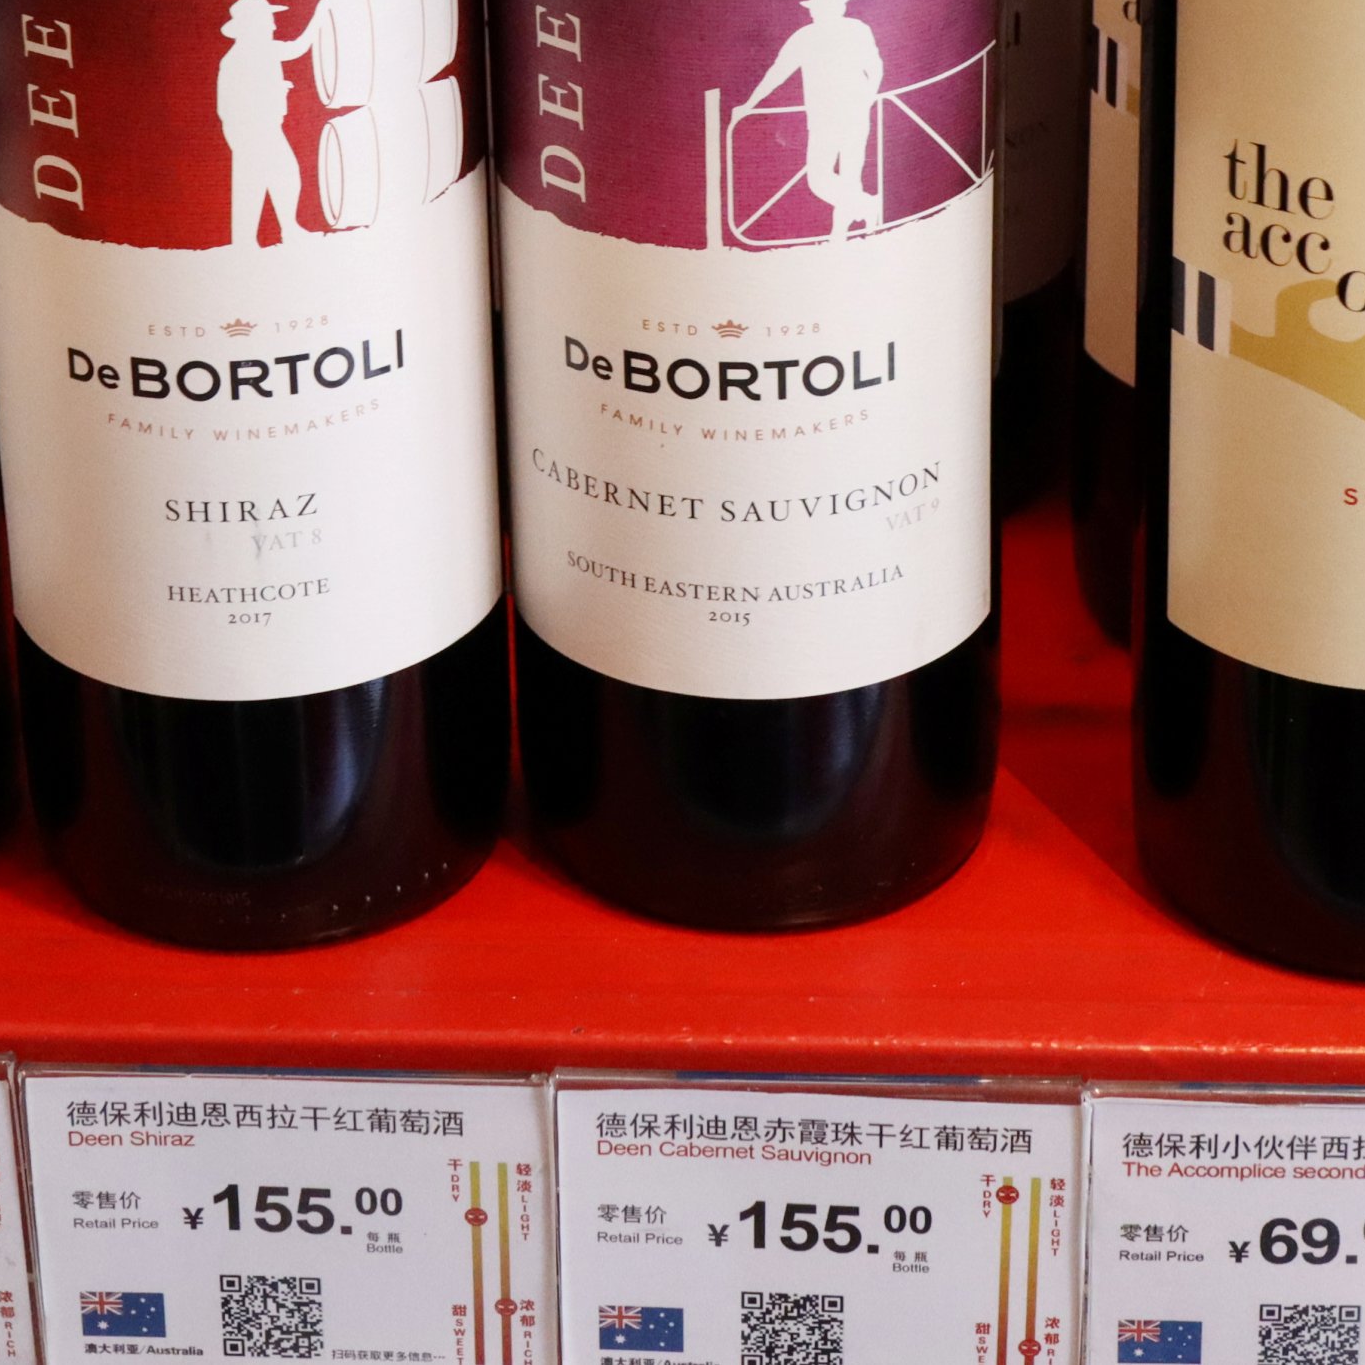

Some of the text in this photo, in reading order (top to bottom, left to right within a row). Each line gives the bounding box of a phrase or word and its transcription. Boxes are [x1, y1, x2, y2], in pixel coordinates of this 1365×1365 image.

[1223, 138, 1335, 220] the
[149, 315, 329, 337] ESTD 1928
[642, 319, 821, 338] ESTD 1928
[108, 399, 380, 441] FAMILY WINEMAKERS
[601, 403, 870, 442] FAMILY WINEMAKERS
[532, 448, 942, 523] CABERNET SAUVIGNON
[165, 492, 318, 523] SHIRAZ
[567, 551, 905, 603] SOUTH EASTERN AUSTRALIA
[167, 578, 329, 604] HEATHCOTE
[228, 611, 272, 626] 2017
[709, 611, 751, 627] 2015
[66, 1100, 464, 1137] 德保利迪恩西拉干红葡萄酒
[67, 1130, 195, 1147] Deen Shiraz
[596, 1112, 1033, 1155] 德保利迪恩赤霞珠干红葡萄酒
[597, 1140, 872, 1167] Deen Cabernet Sauvignon
[1123, 1162, 1164, 1179] The
[1168, 1162, 1286, 1182] Accomplice
[72, 1190, 141, 1210] 零售价
[73, 1217, 159, 1229] Retail Price
[366, 1243, 404, 1254] Bottle
